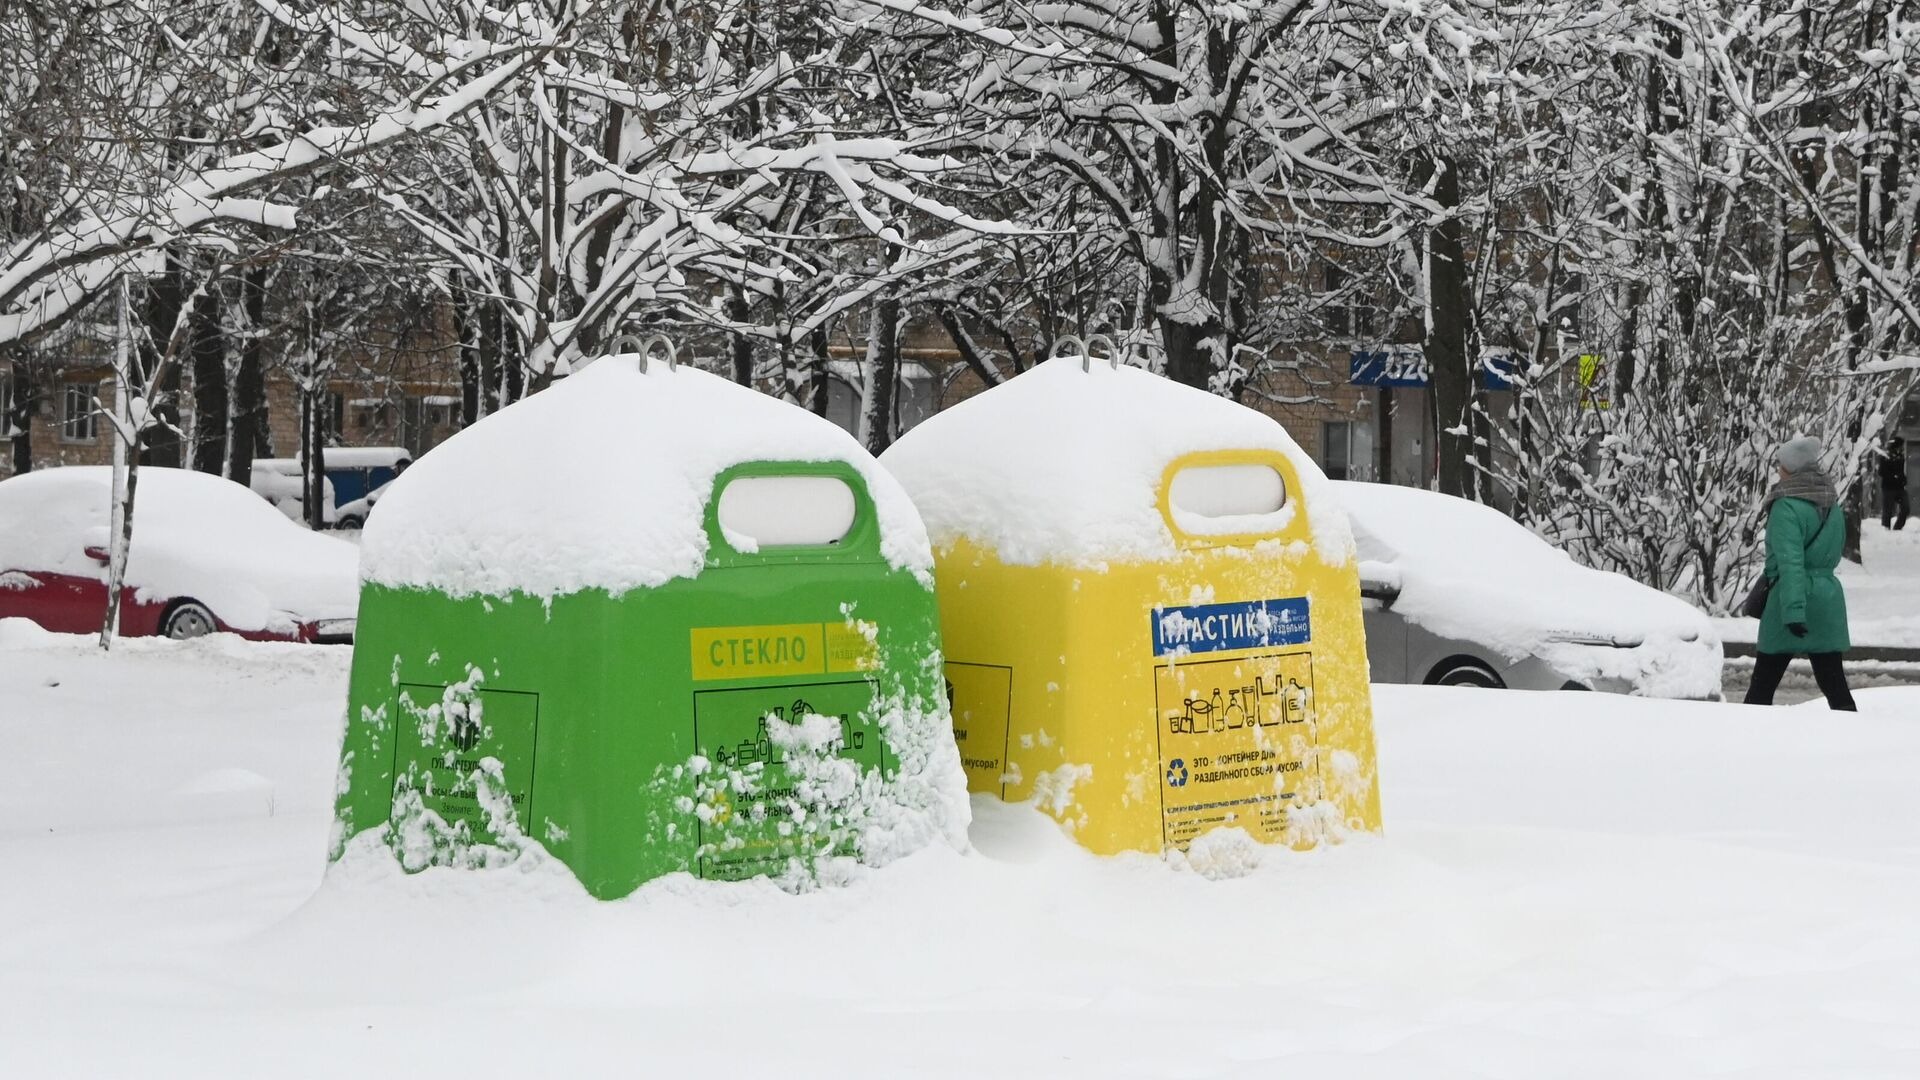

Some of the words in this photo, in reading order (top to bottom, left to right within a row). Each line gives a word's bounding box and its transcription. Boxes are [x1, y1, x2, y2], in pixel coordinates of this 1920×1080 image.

[1160, 612, 1257, 645] ПЛАСТИК
[709, 636, 806, 667] СТЕКЛО
[431, 757, 445, 769] ГУП
[964, 758, 999, 771] мусора?
[1193, 756, 1209, 768] ЭТО
[1194, 767, 1249, 783] РАЗДЕЛЬНОГО
